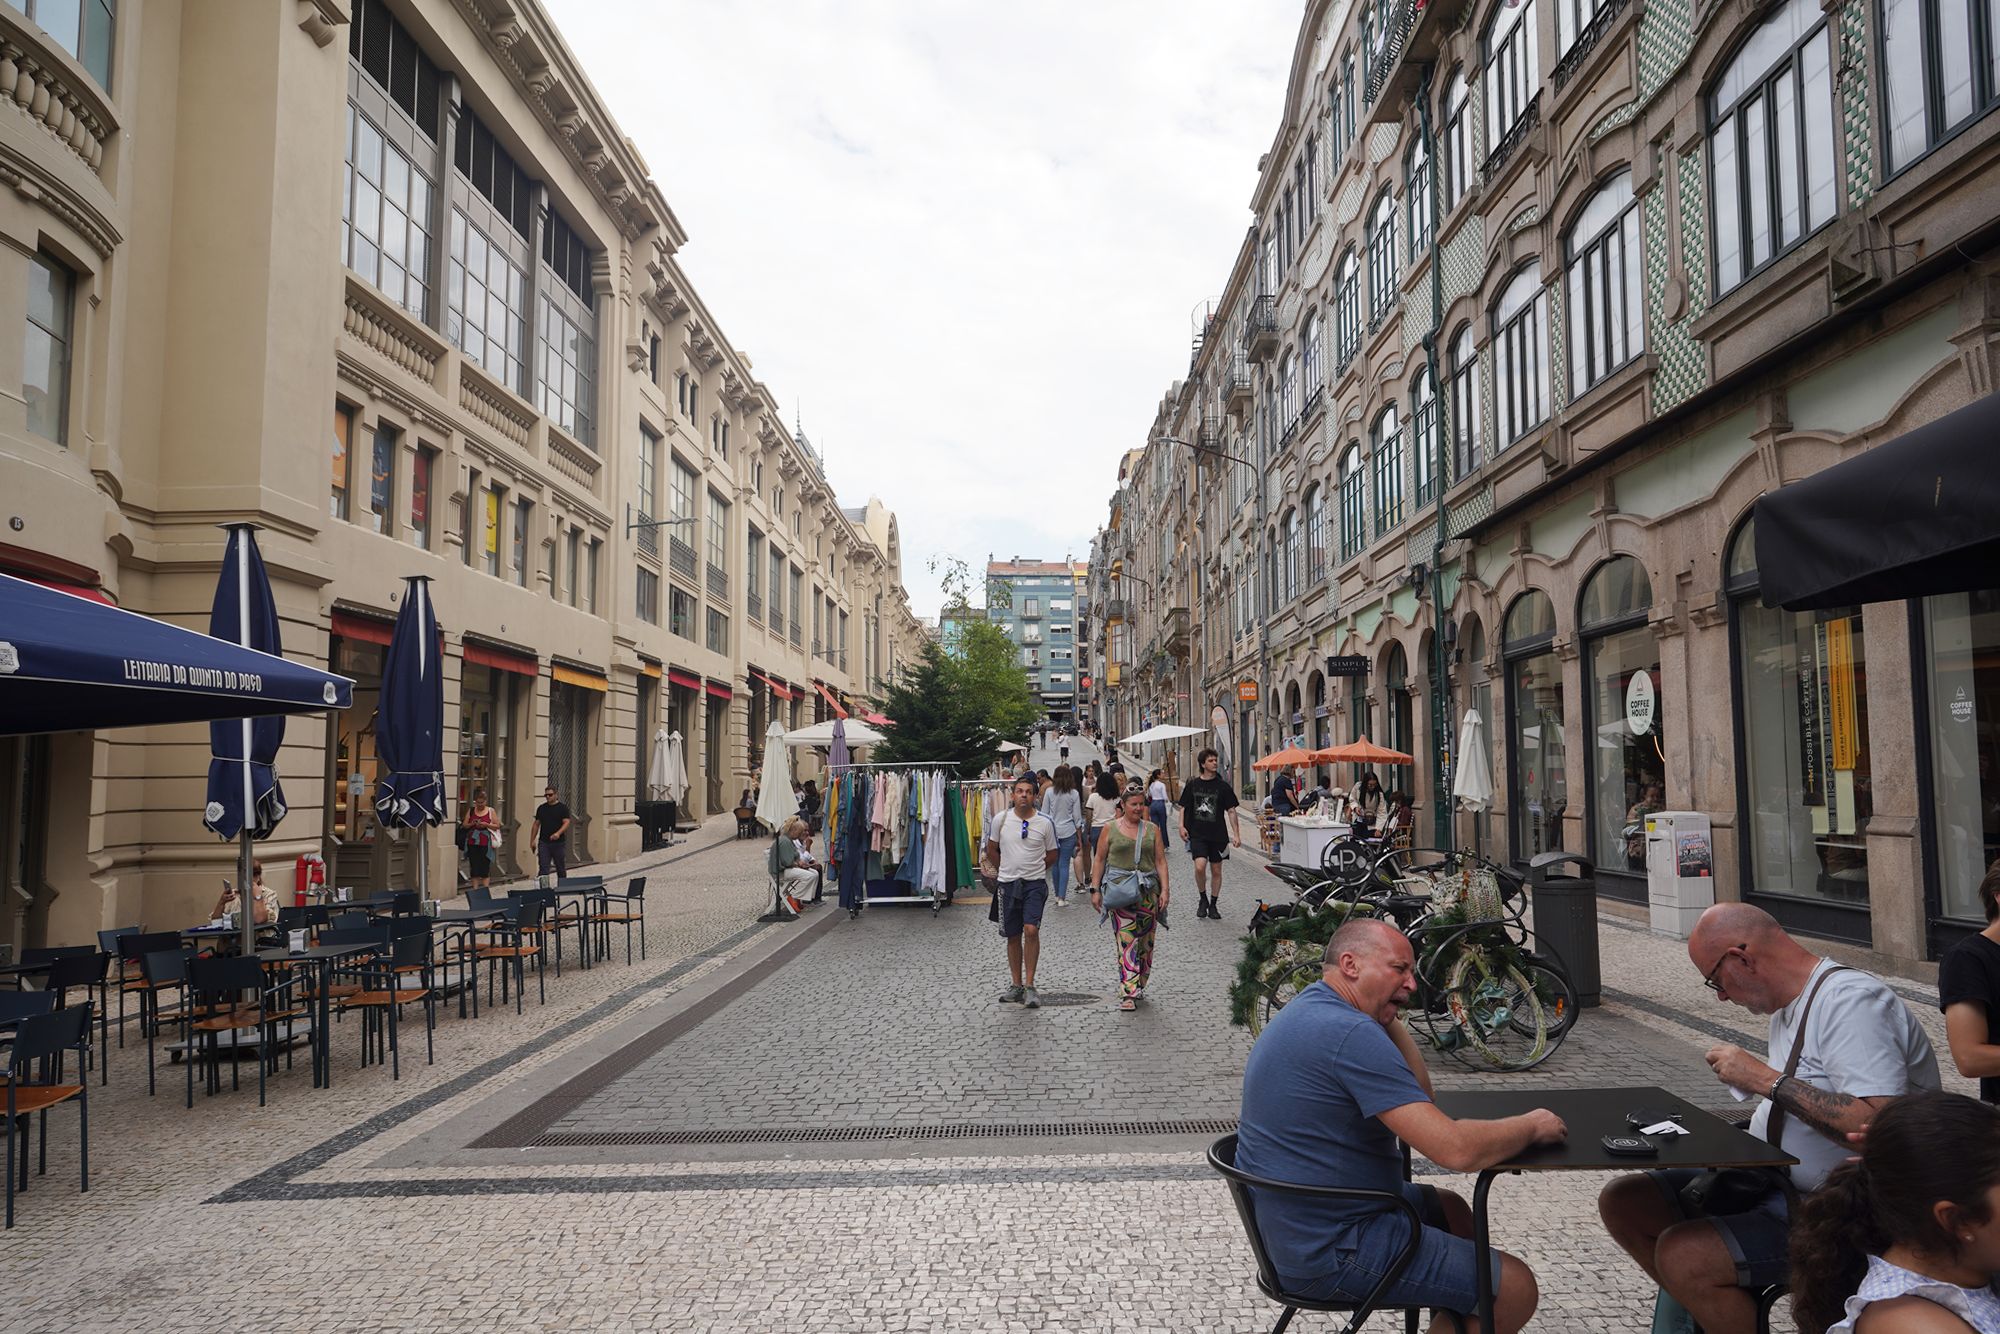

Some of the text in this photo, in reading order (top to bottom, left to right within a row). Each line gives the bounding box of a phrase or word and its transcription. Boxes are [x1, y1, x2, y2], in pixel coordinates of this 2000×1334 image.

[123, 659, 262, 692] LEITARIA DA QUINTA DO PAÇO
[1630, 699, 1650, 709] COFFEE
[1950, 701, 1972, 709] COFFEE
[1631, 708, 1648, 717] HOUSE
[1804, 717, 1814, 782] IMPOSSIBLE
